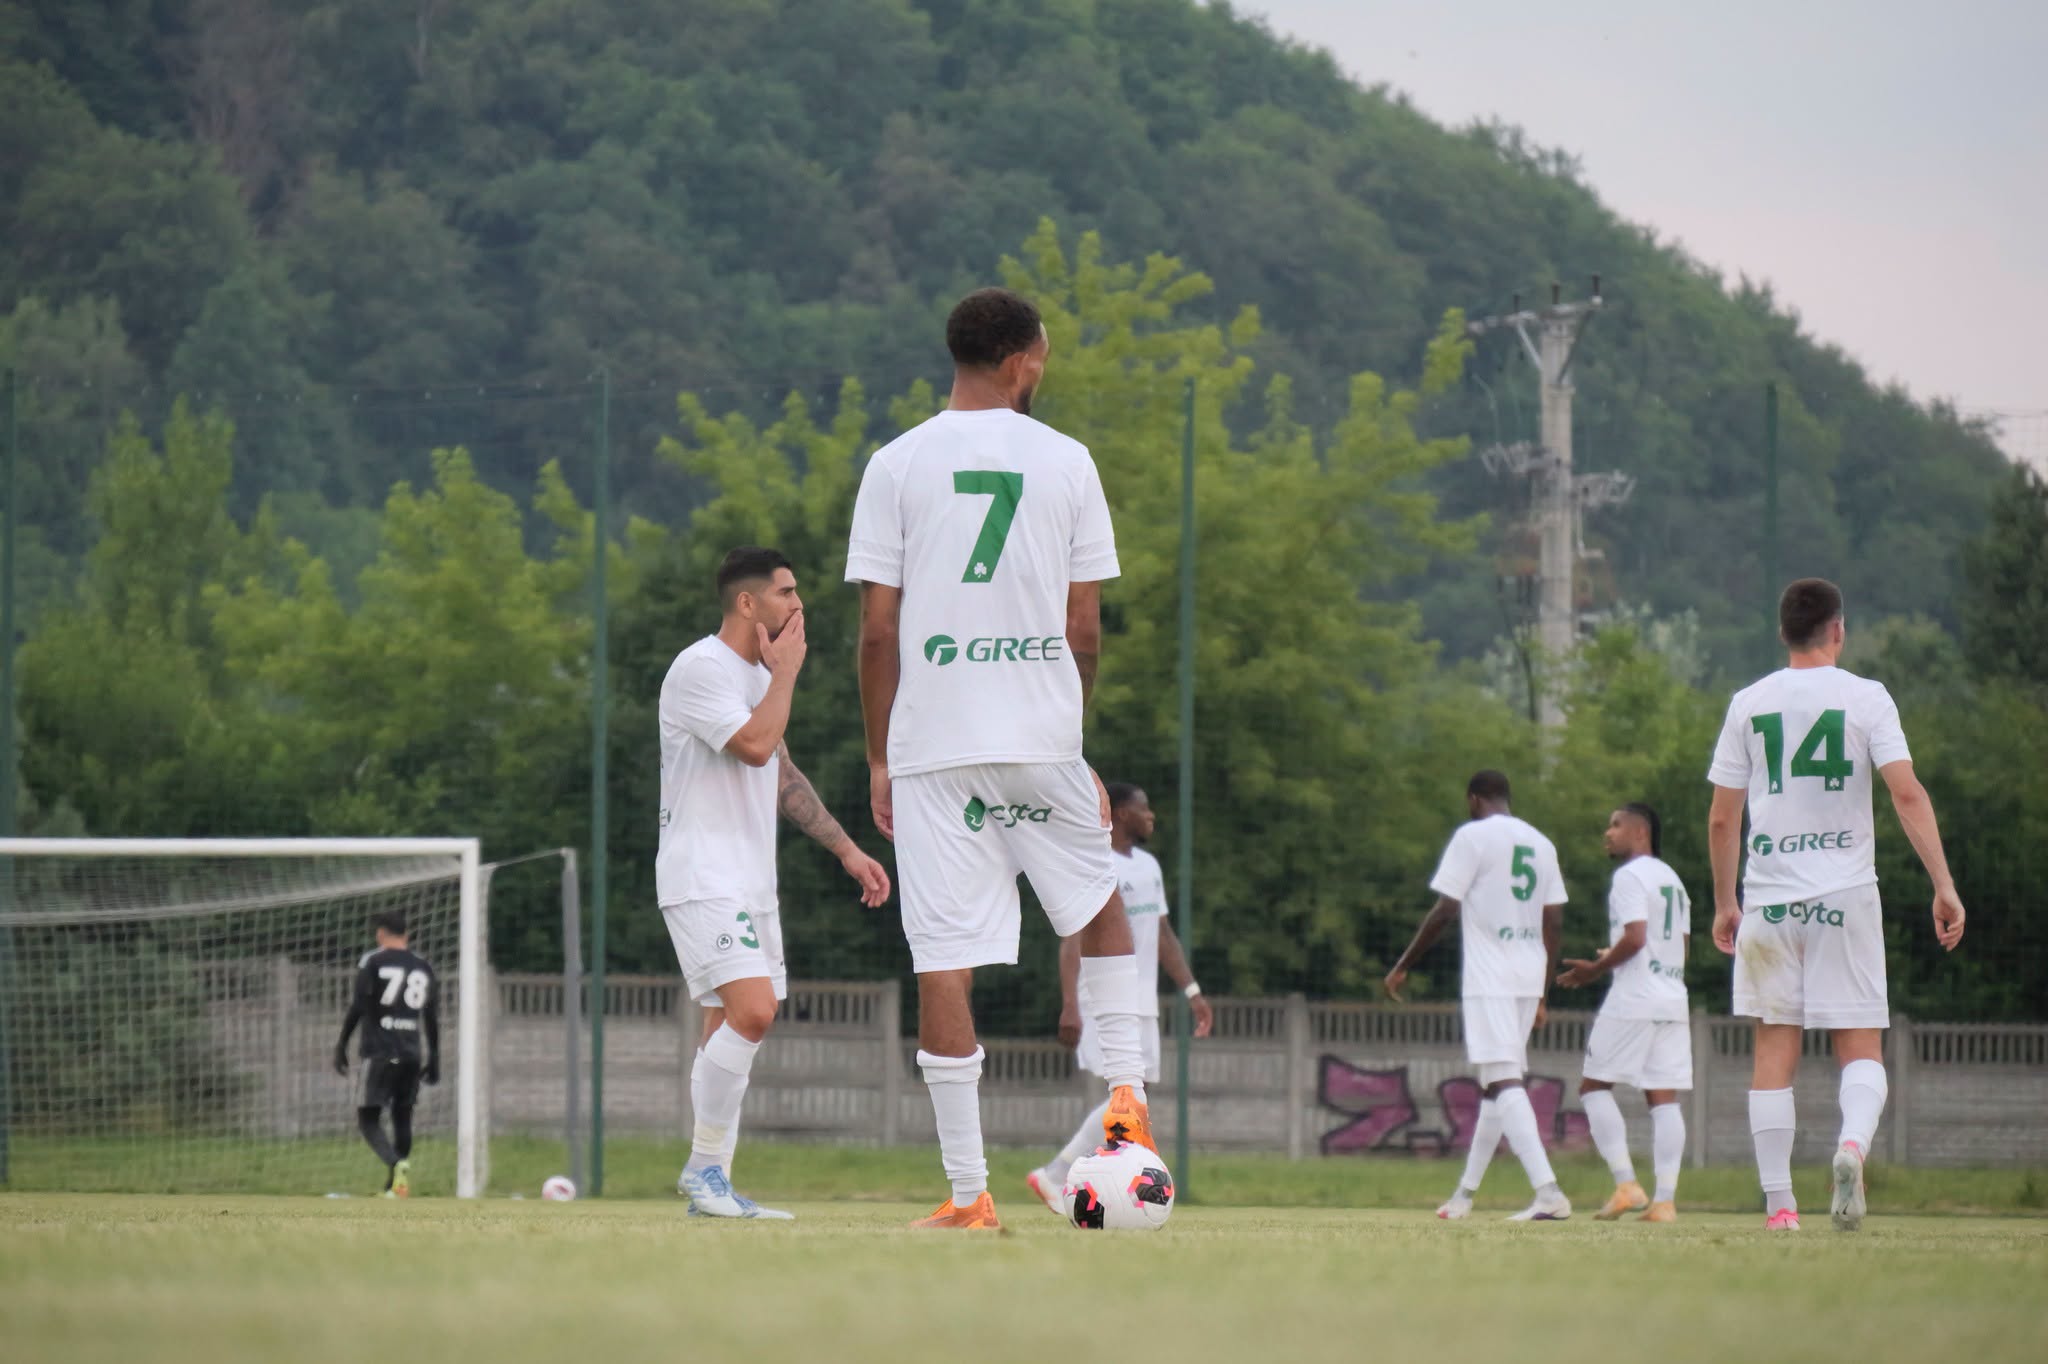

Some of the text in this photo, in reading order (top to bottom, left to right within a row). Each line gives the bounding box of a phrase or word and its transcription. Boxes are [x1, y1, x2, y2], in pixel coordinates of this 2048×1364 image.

[953, 470, 1023, 583] 7
[966, 637, 1063, 662] GREE
[1751, 709, 1853, 794] 14
[1779, 830, 1853, 853] GREE
[1511, 845, 1536, 901] 5
[736, 911, 760, 949] 3
[1789, 901, 1844, 928] cyta
[378, 967, 429, 1010] 78
